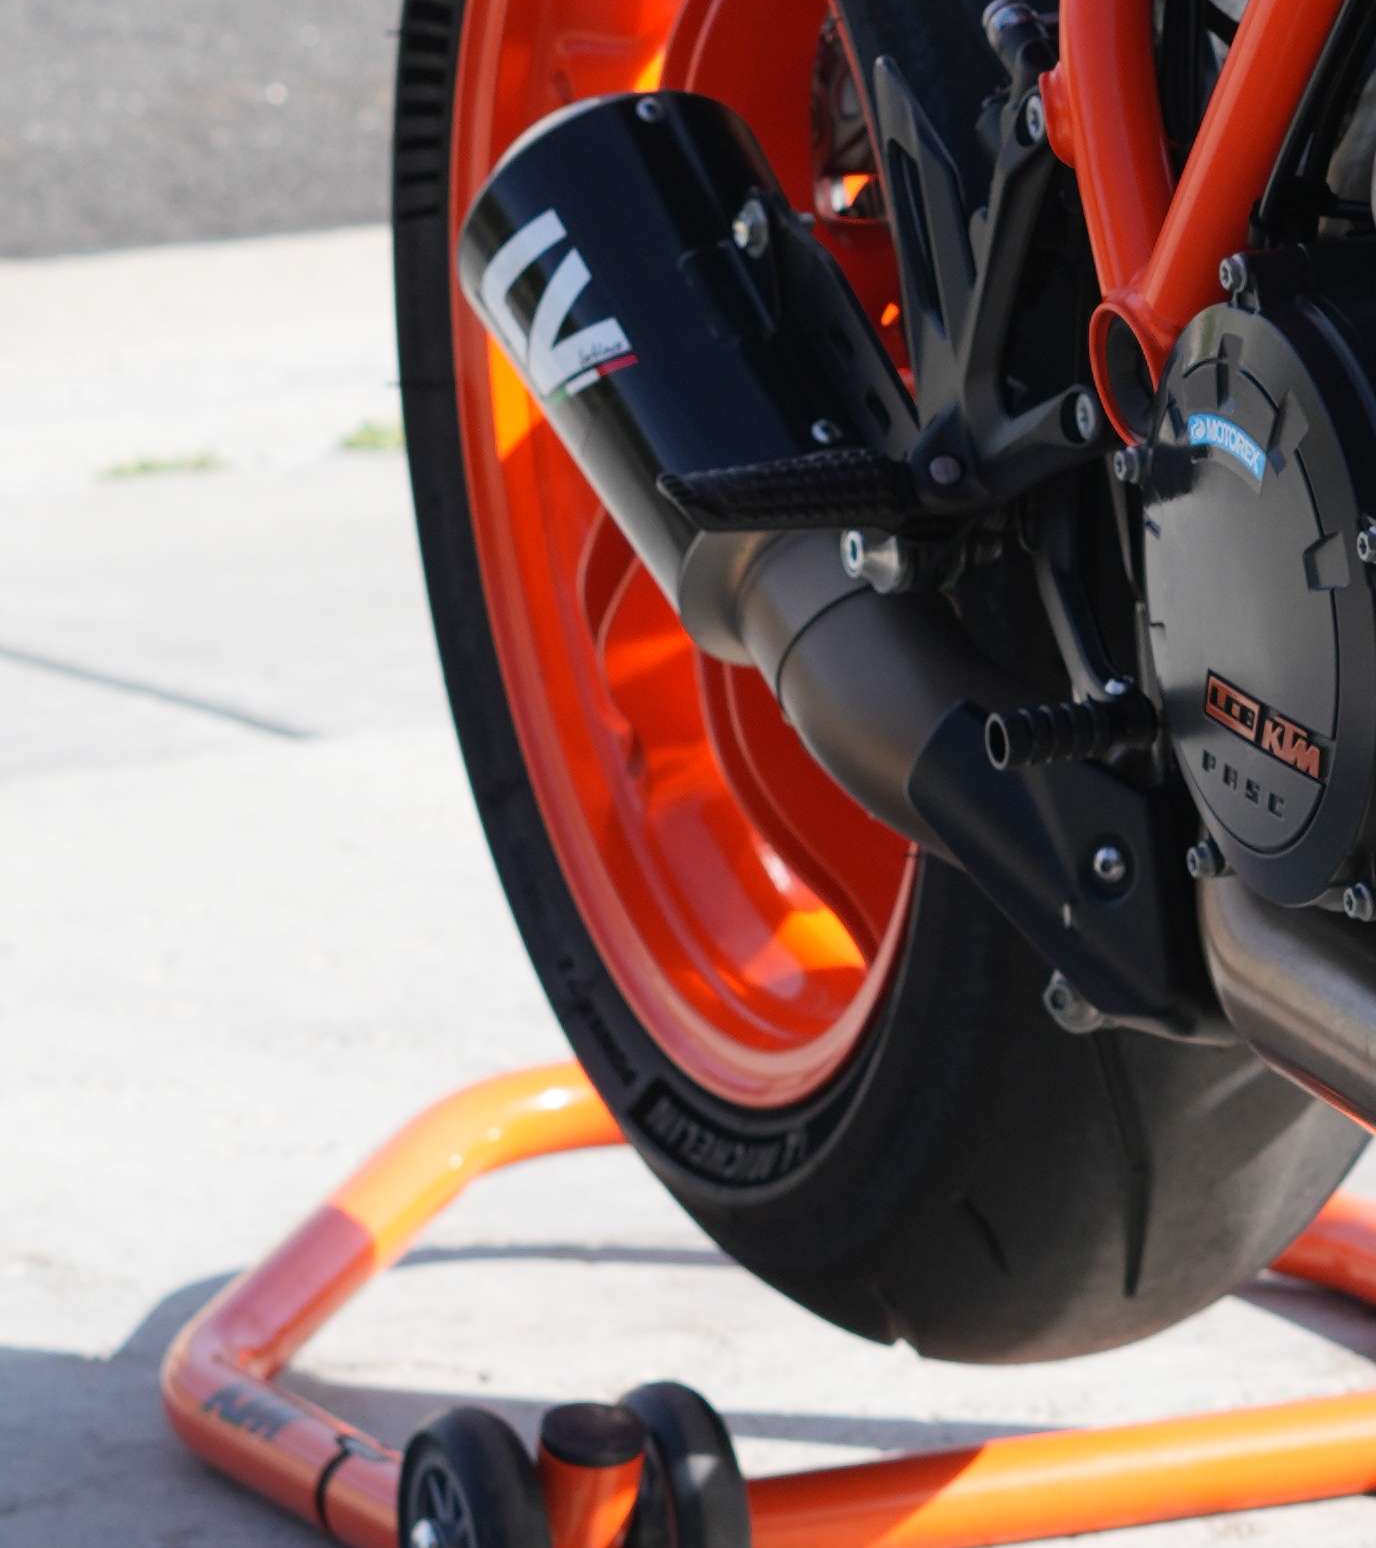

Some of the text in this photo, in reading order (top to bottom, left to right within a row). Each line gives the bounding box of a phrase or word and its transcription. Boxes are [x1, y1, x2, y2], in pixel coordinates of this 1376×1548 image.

[1206, 417, 1261, 475] MOTOREX
[1261, 714, 1321, 779] KTM
[1202, 750, 1286, 819] PASC
